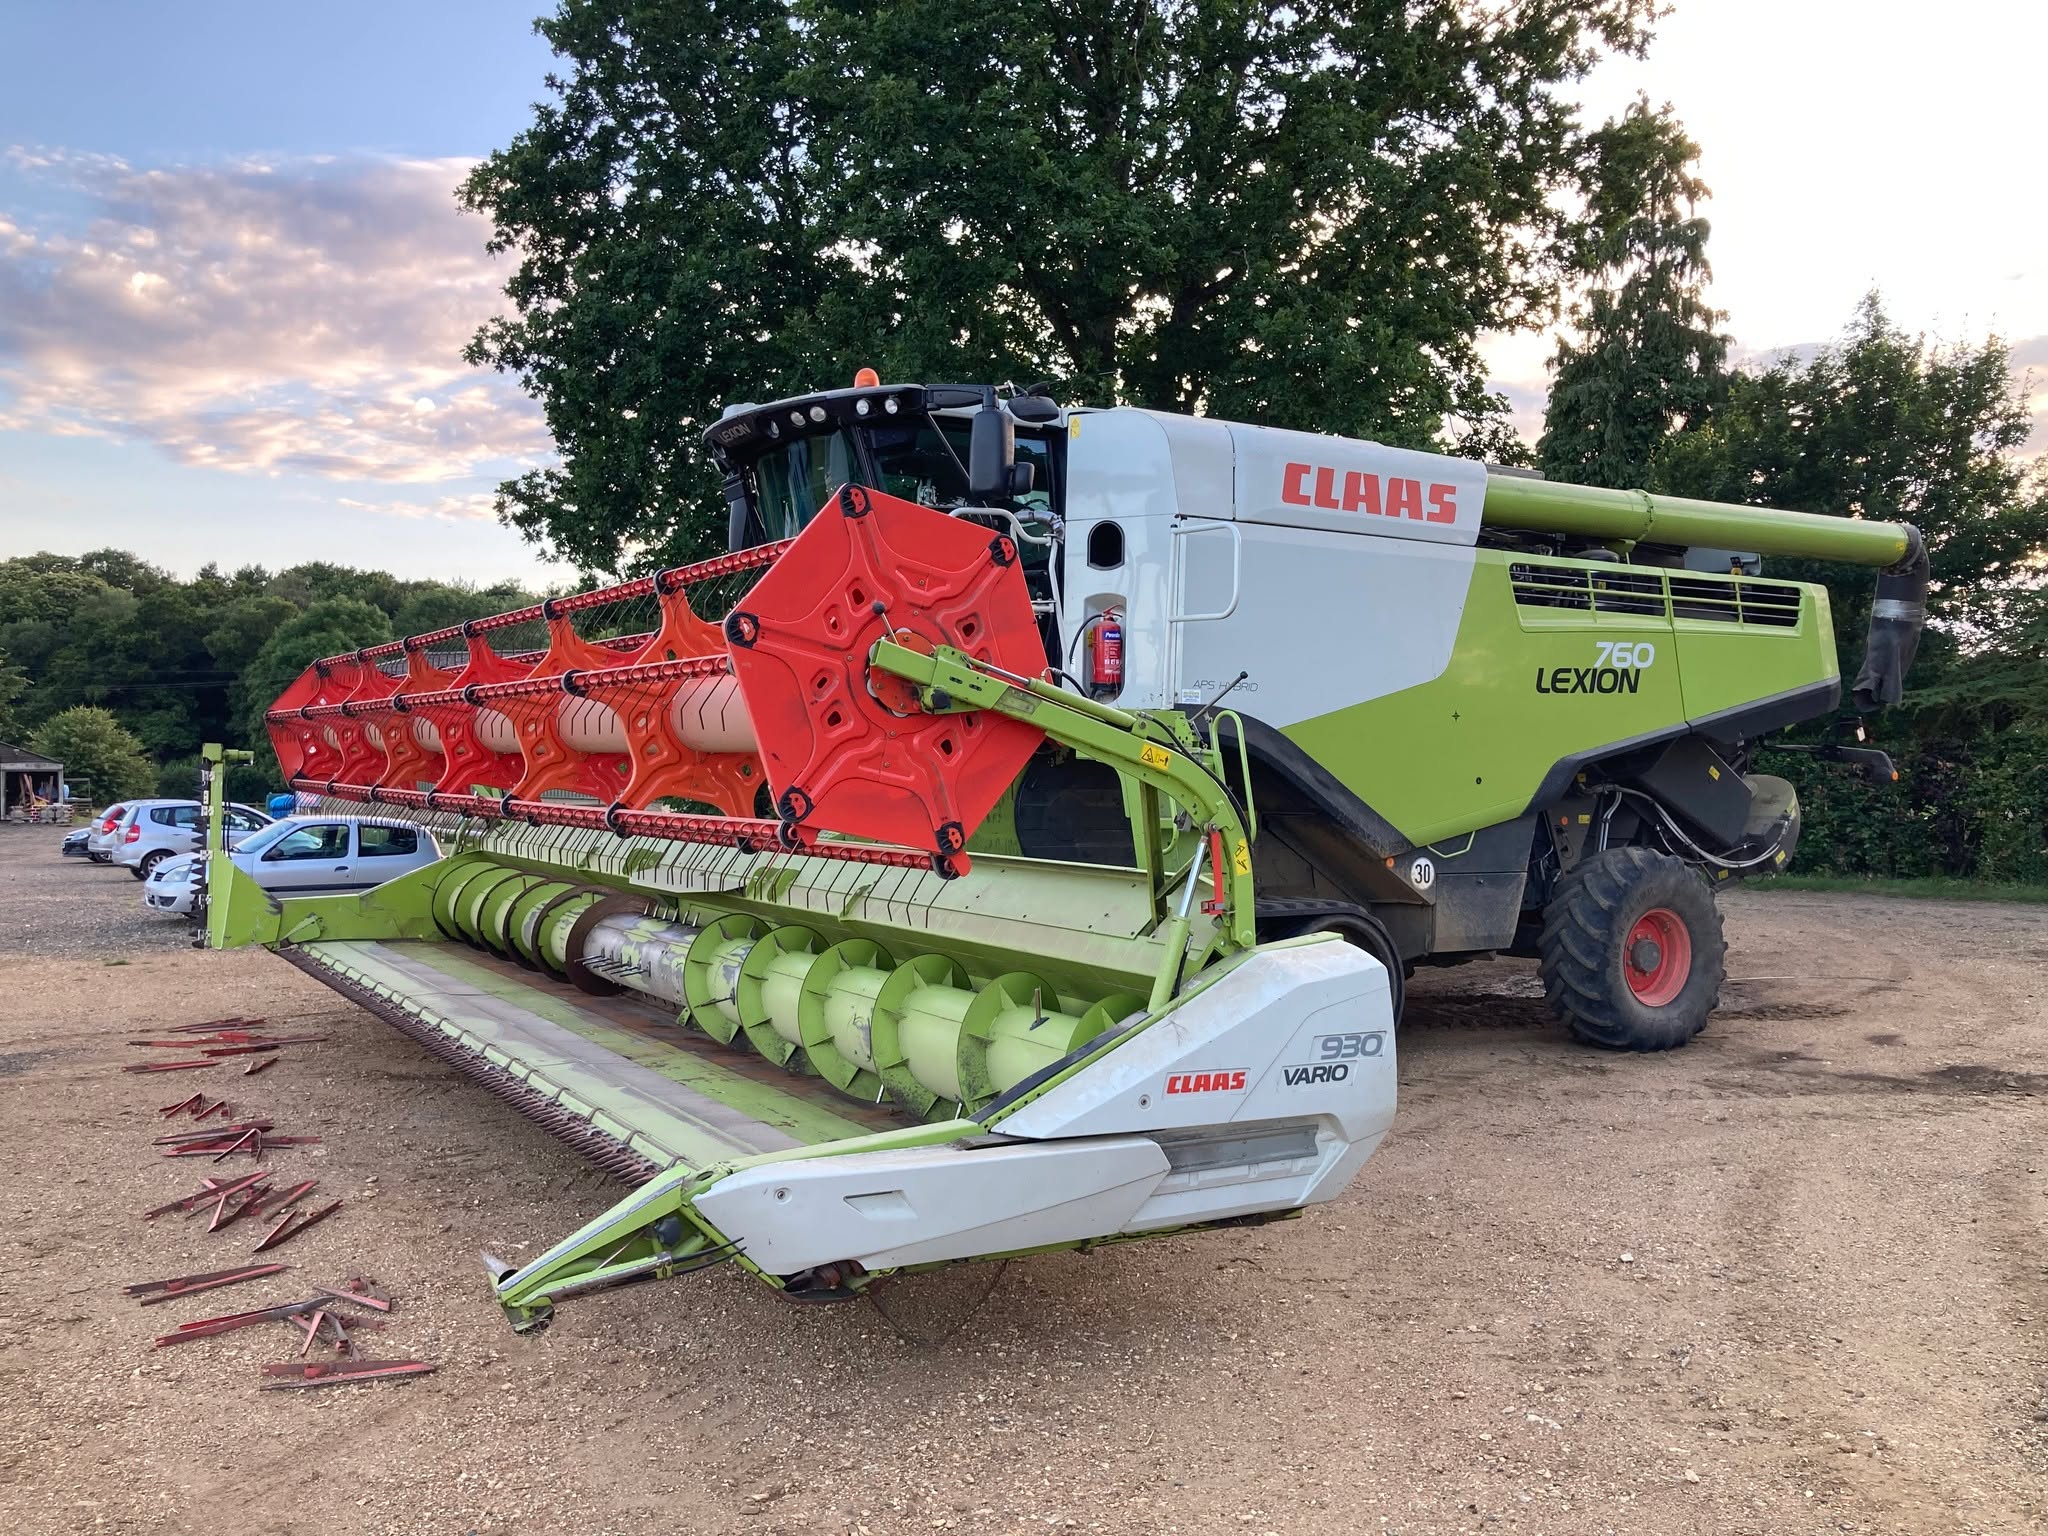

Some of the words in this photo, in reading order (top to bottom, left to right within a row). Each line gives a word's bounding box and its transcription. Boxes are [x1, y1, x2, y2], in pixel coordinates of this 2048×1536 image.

[719, 423, 751, 442] LEXION
[1282, 463, 1457, 524] CLAAS
[1594, 641, 1655, 668] 760
[1193, 679, 1216, 690] APS
[1536, 667, 1641, 694] LEXION
[1415, 864, 1431, 884] 30
[1320, 1033, 1383, 1061] 930
[1166, 1071, 1247, 1095] CLAAS
[1284, 1064, 1349, 1086] VARIO
